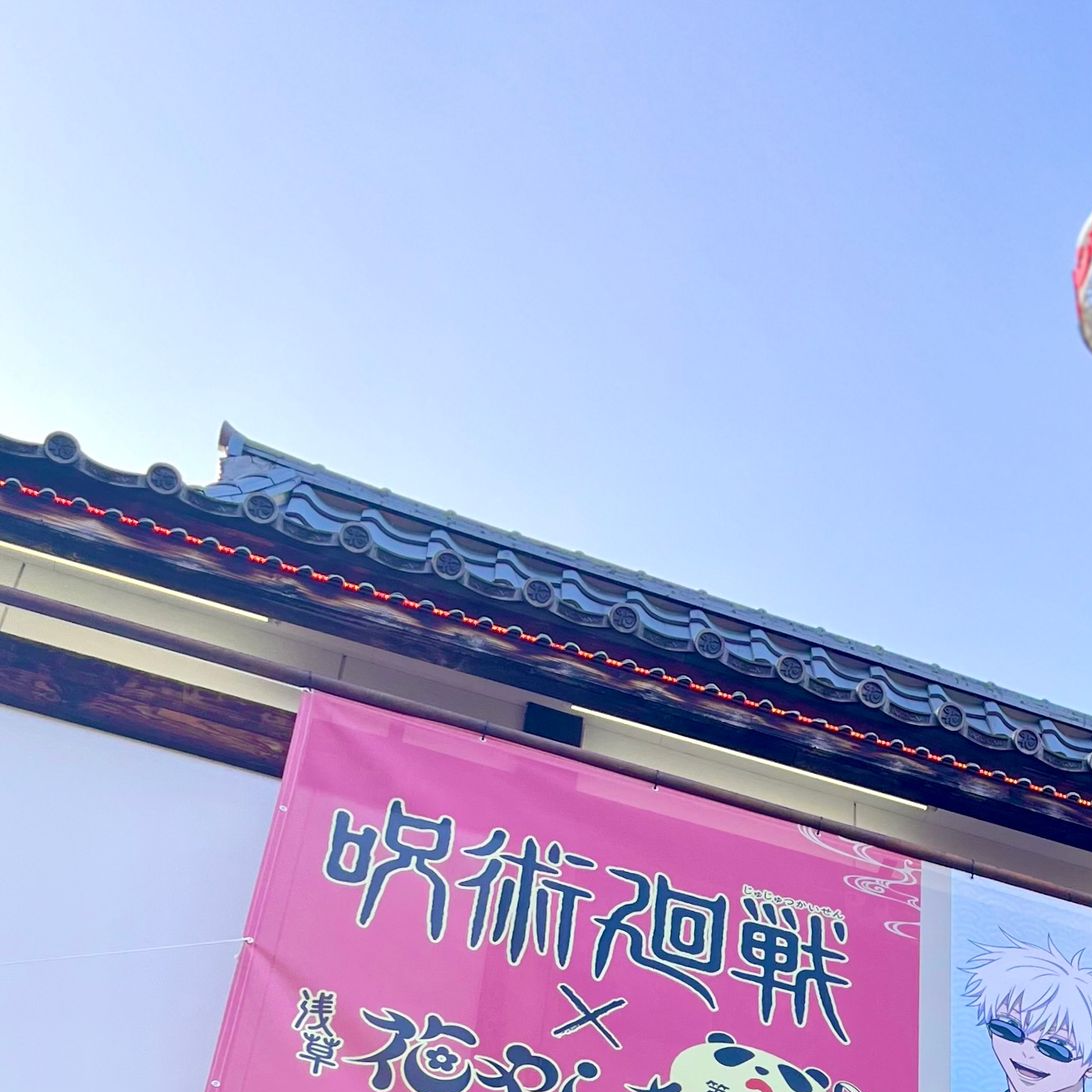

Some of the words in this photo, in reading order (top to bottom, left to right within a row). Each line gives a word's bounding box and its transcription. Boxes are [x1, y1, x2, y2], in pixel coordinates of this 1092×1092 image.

[324, 799, 851, 1045] 呪術廻戦
[742, 884, 845, 920] じゅじゅつかいせん
[292, 988, 343, 1076] 浅草
